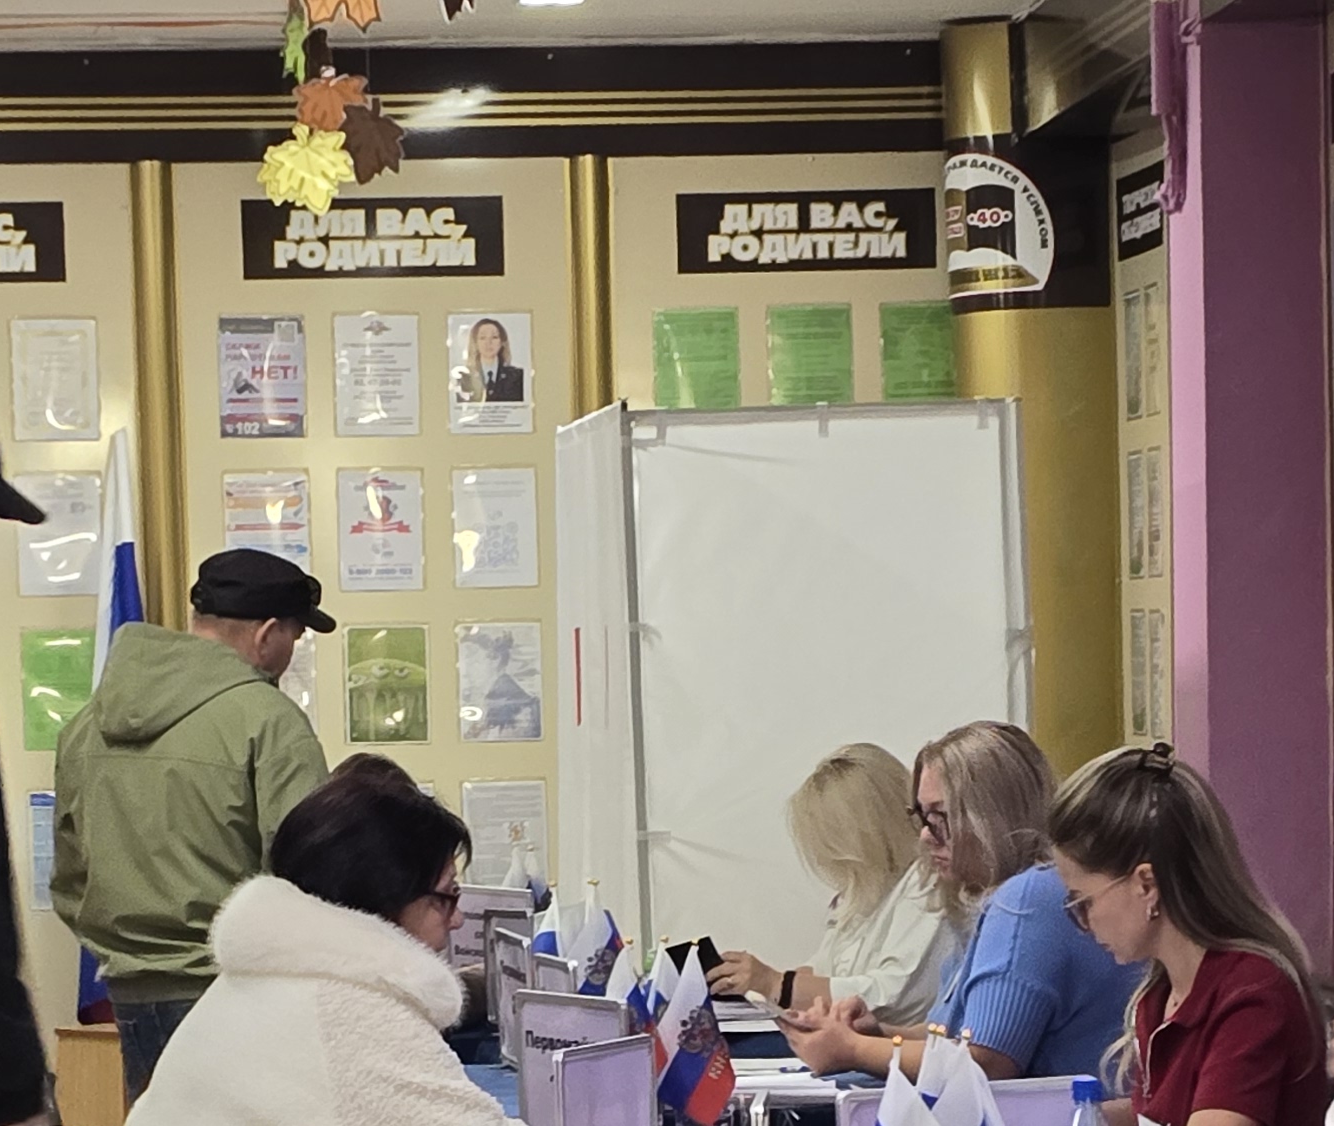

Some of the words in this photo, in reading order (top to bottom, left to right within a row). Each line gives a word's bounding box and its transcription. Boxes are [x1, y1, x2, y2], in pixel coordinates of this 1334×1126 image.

[285, 208, 366, 240] ДЛЯ
[375, 206, 467, 240] ВАС,
[720, 203, 798, 235] ДЛЯ
[809, 201, 899, 231] ВАС,
[1020, 184, 1049, 249] УСПЕХОМ
[273, 237, 476, 271] РОДИТЕЛИ
[707, 230, 907, 265] РОДИТЕЛИ
[250, 365, 299, 380] НЕТ!
[236, 422, 261, 435] 102
